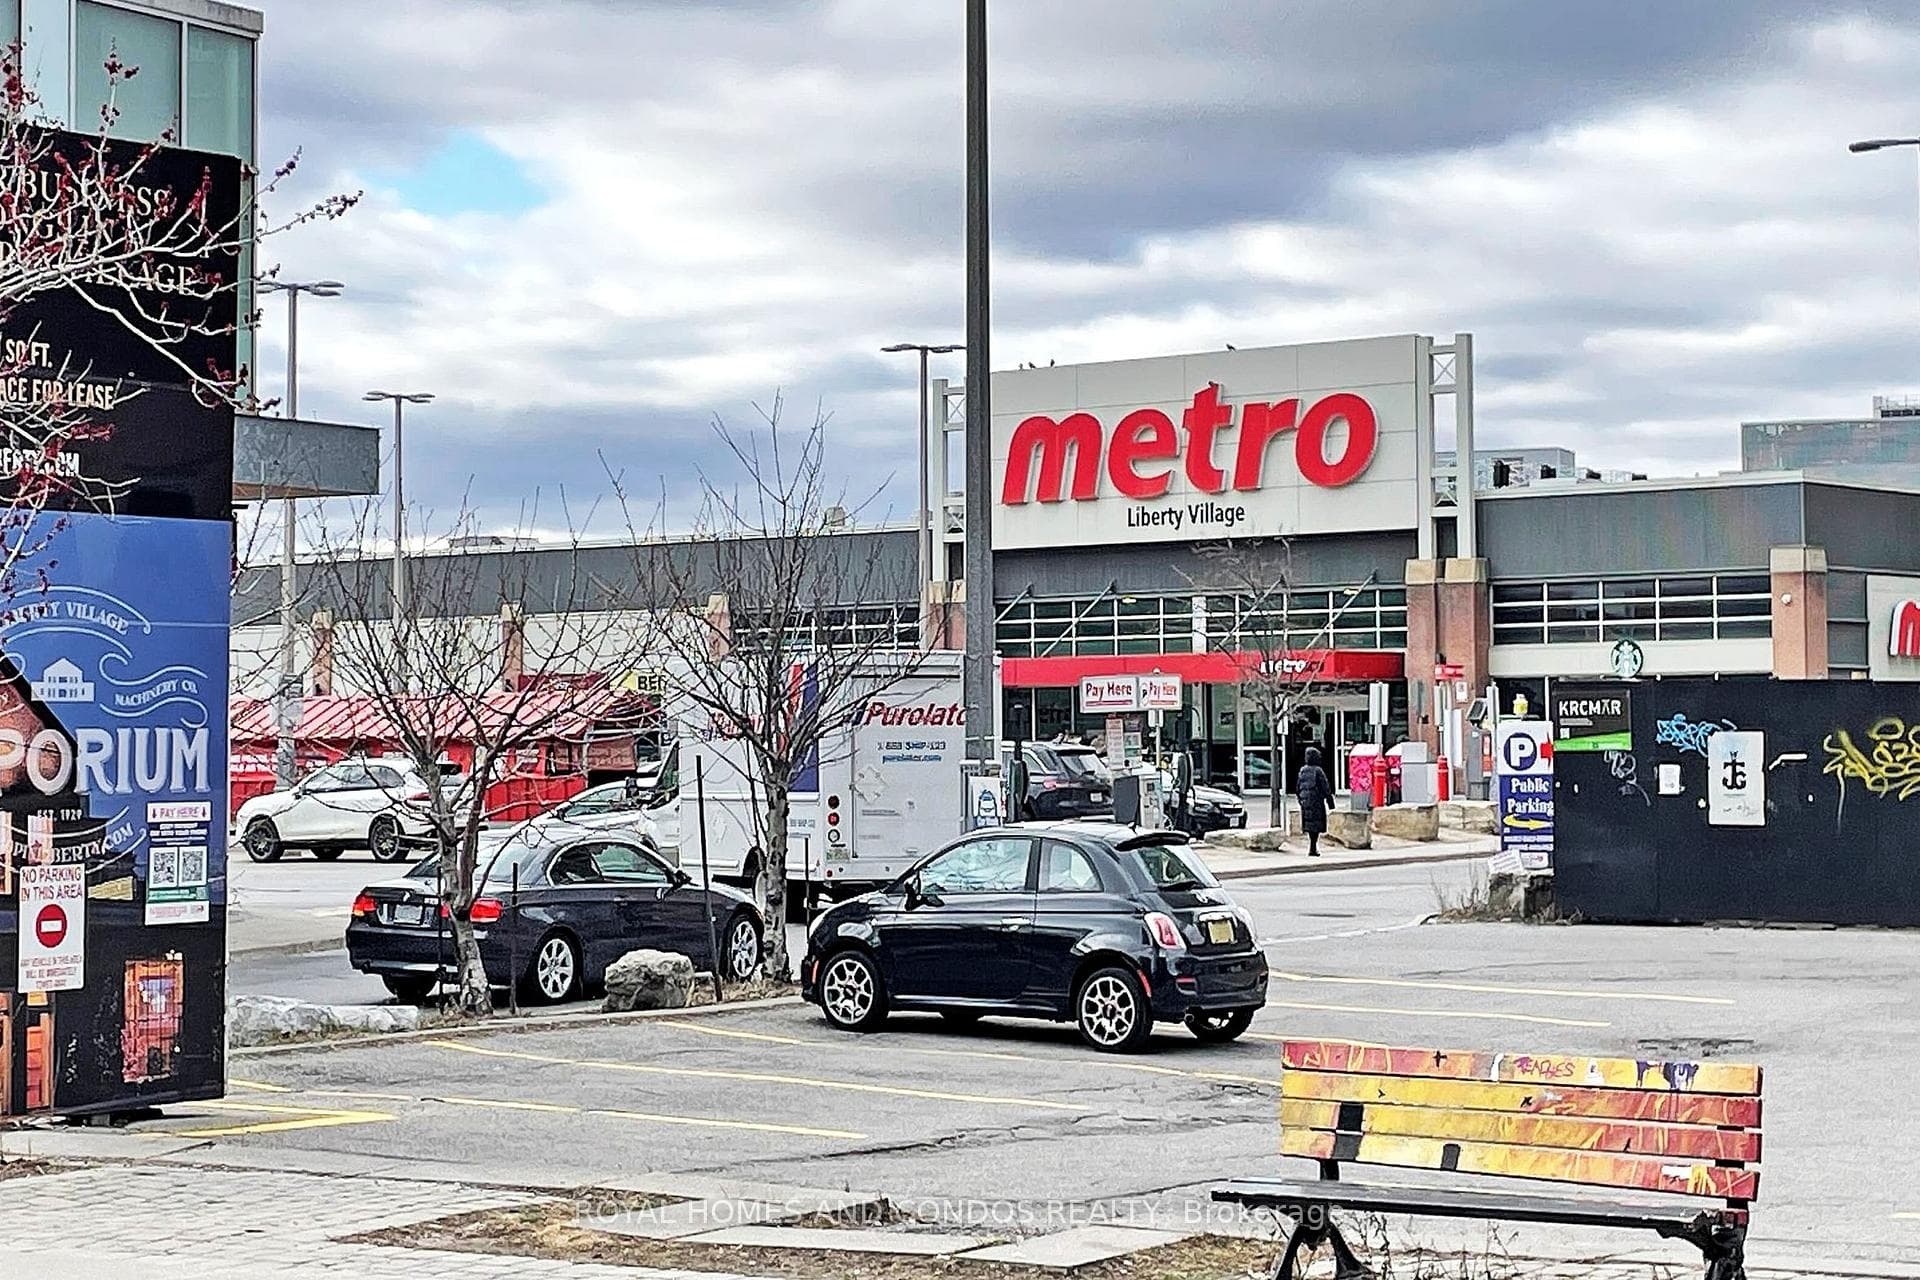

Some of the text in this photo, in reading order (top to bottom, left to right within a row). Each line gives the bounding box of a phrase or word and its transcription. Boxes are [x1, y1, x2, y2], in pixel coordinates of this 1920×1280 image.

[68, 381, 114, 410] LEASE
[1002, 382, 1379, 506] metro
[1127, 502, 1245, 530] Liberty Village
[66, 601, 129, 636] VILLAGE
[1086, 680, 1132, 700] Pay Here
[1510, 777, 1549, 793] Public
[1507, 798, 1554, 817] Parking
[22, 866, 82, 884] NO PARKING
[21, 887, 31, 902] IN
[33, 885, 55, 899] THIS
[57, 883, 83, 899] AREA
